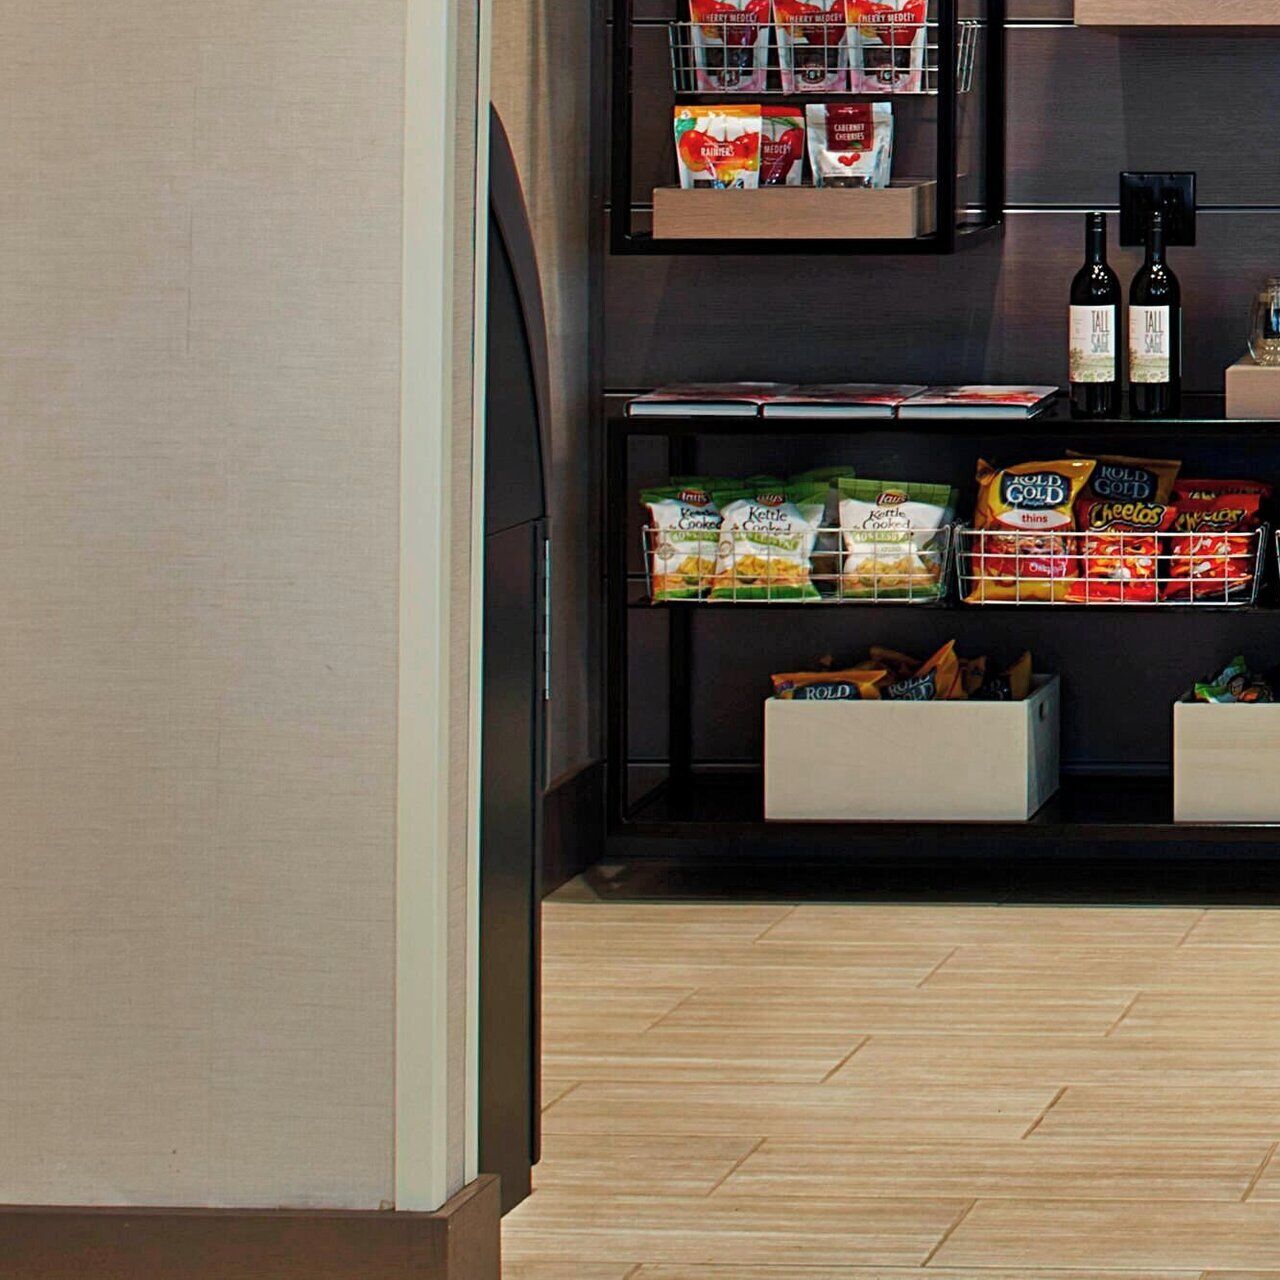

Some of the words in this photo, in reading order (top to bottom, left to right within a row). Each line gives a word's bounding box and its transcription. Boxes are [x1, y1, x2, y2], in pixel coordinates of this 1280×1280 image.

[858, 14, 886, 23] CHERRY
[888, 13, 915, 22] MEDLEY
[835, 132, 865, 141] CHERRIES
[1091, 310, 1110, 332] TALL
[1145, 310, 1164, 333] TALL
[1013, 475, 1062, 486] ROLD
[1101, 466, 1147, 482] ROLD
[1006, 485, 1064, 504] GOLD
[1095, 479, 1149, 498] GOLD
[876, 492, 903, 506] Lay's
[750, 507, 787, 521] Kettle
[870, 508, 906, 521] Kettle
[1022, 514, 1048, 523] thins
[1090, 502, 1163, 527] Cheetos
[862, 519, 911, 531] Cooked
[806, 684, 851, 700] ROLD
